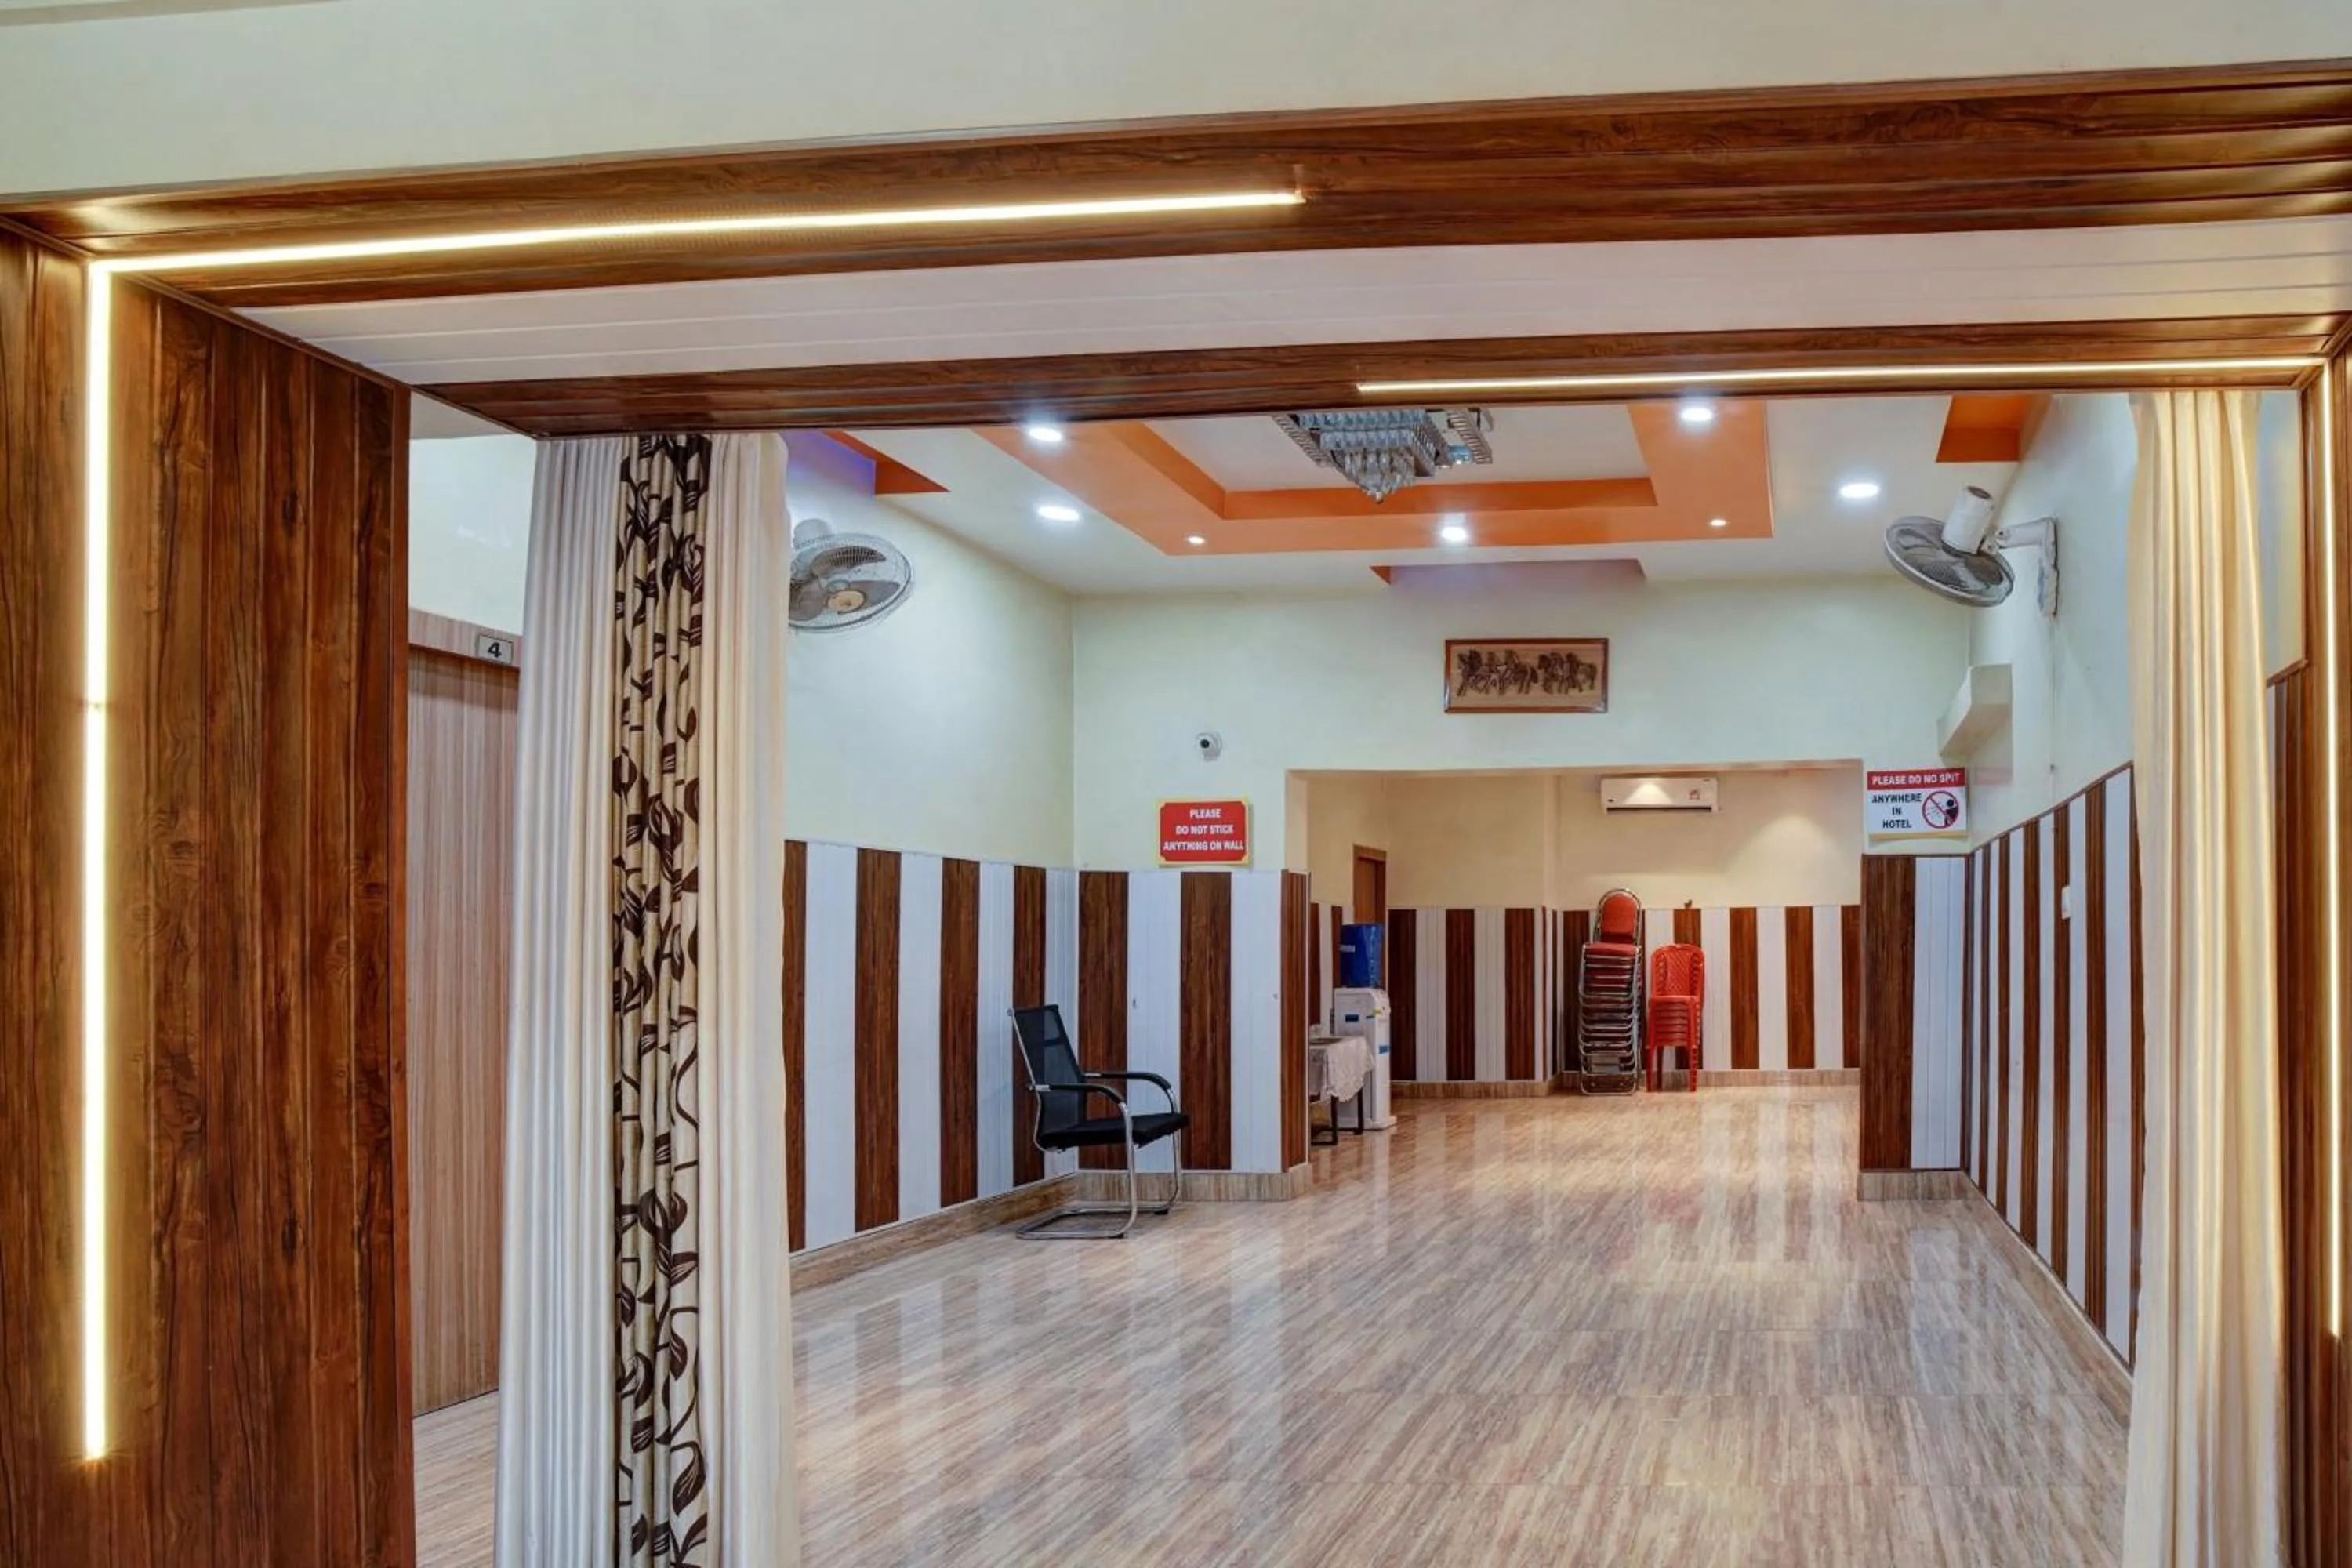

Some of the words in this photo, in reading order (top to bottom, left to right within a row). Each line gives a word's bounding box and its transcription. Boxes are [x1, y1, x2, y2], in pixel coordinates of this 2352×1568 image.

[488, 642, 502, 659] 4
[1872, 775, 1907, 785] PLEASE
[1908, 775, 1922, 784] DO
[1939, 773, 1959, 783] SPIT
[1871, 793, 1922, 804] ANYWHERE
[1189, 808, 1221, 818] PLEASE
[1892, 807, 1902, 815] IN
[1175, 825, 1189, 835] DO
[1190, 825, 1207, 835] NOT
[1210, 824, 1233, 834] STICK
[1882, 819, 1912, 829] HOTEL
[1163, 840, 1207, 851] ANYTHING
[1210, 840, 1221, 851] ON
[1224, 840, 1243, 850] WALL
